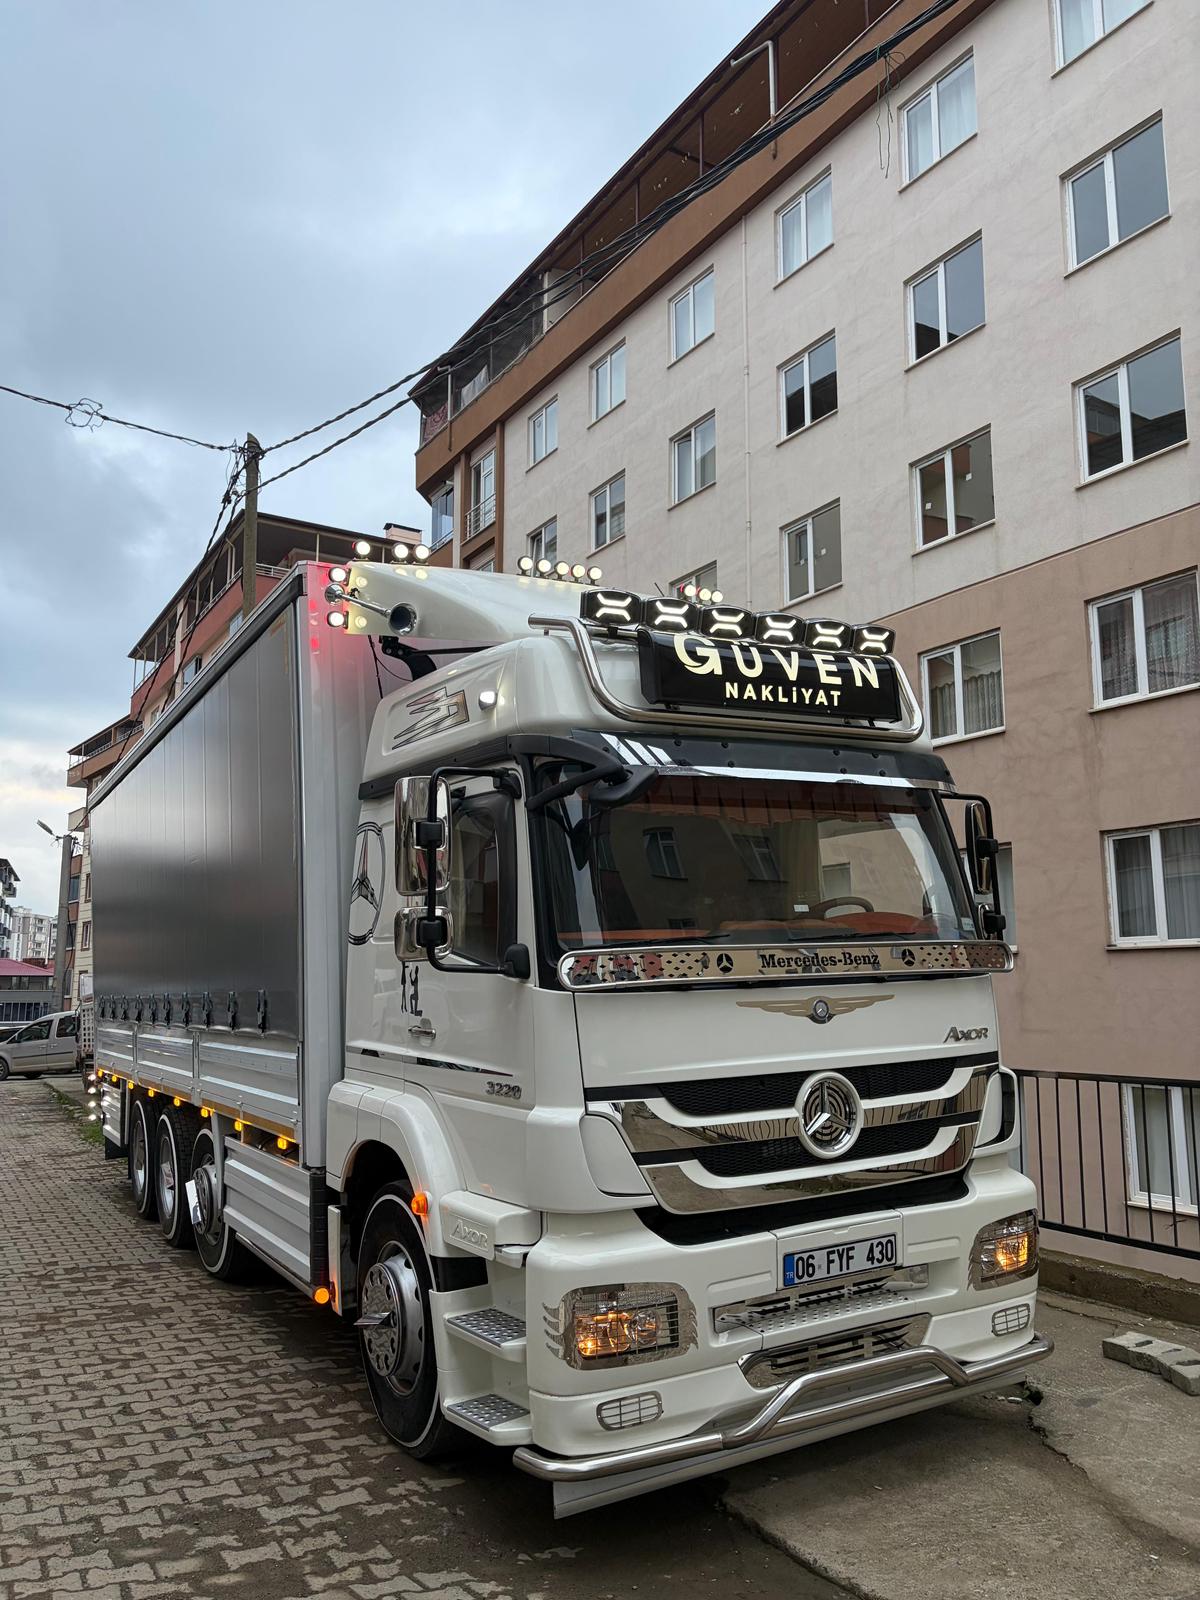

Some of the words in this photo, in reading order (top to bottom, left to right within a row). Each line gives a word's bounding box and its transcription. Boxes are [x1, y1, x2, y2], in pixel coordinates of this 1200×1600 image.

[673, 635, 880, 689] GÜVEN
[759, 951, 880, 969] Mercedes-Benz
[785, 1271, 794, 1280] TR
[795, 1254, 816, 1280] 06
[826, 1246, 855, 1275] FYF
[866, 1239, 894, 1265] 430
